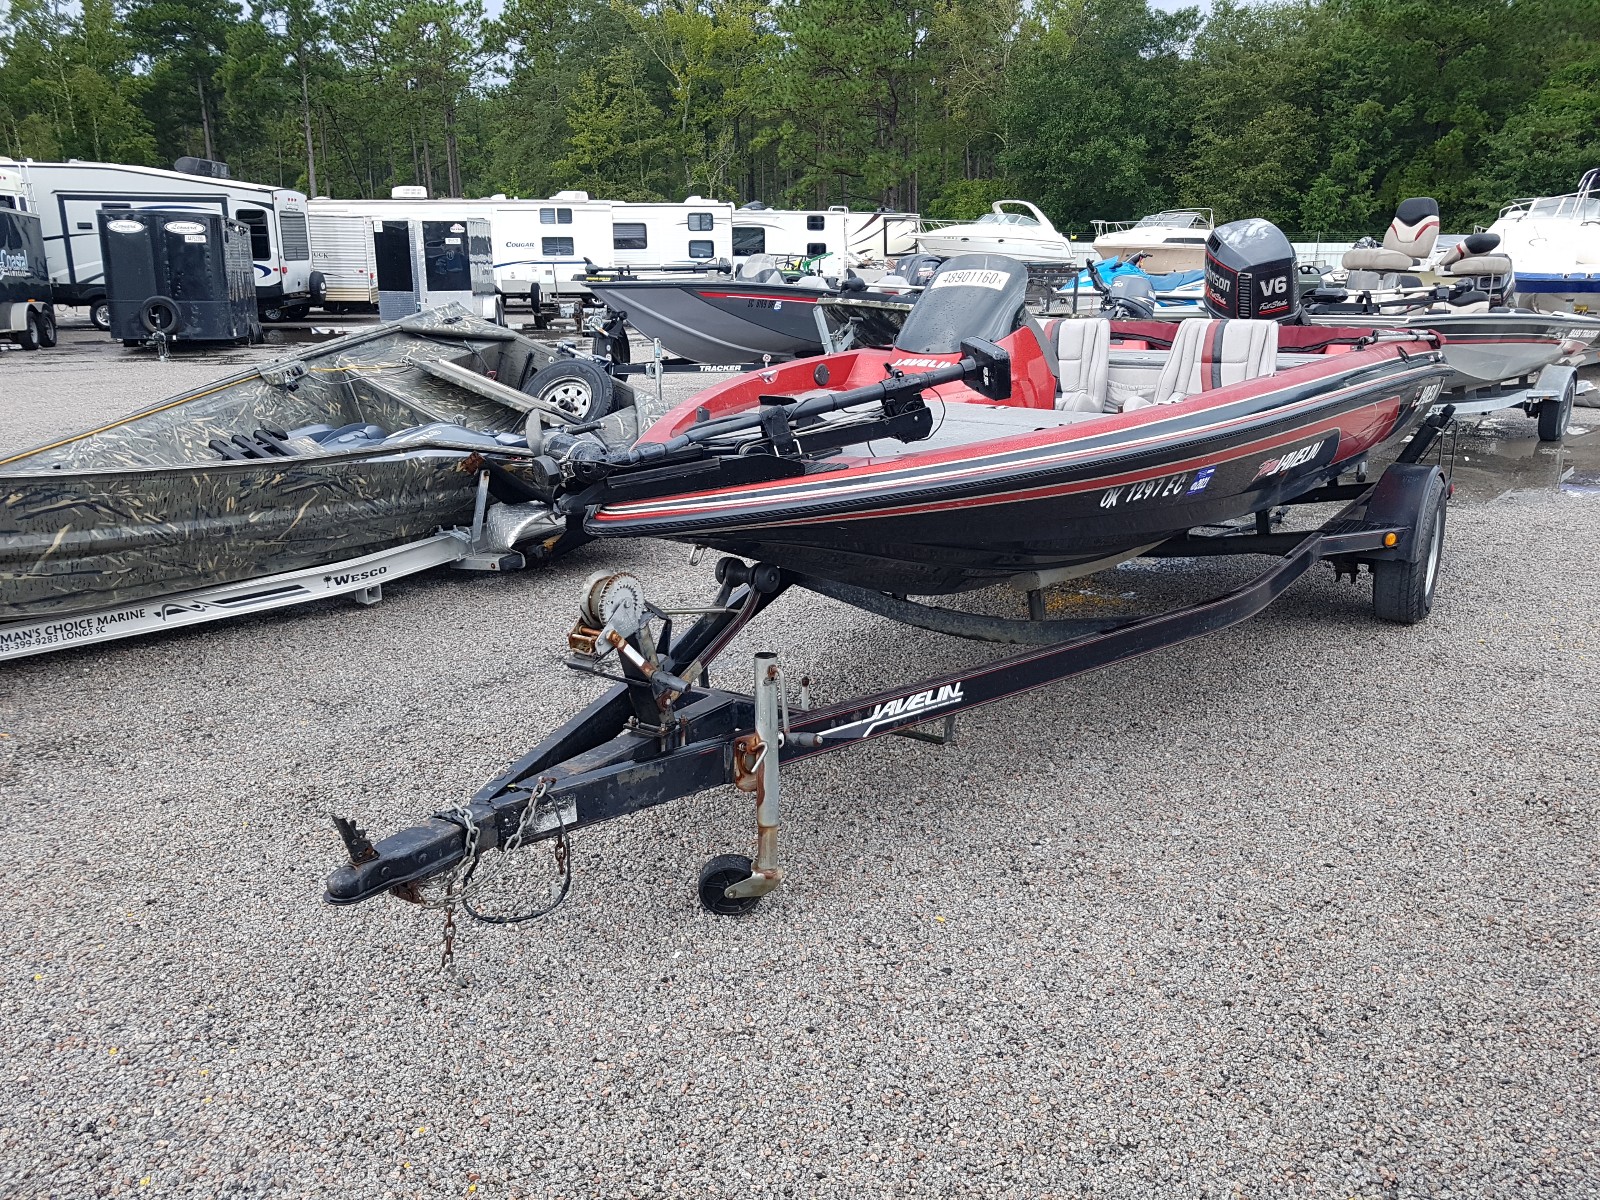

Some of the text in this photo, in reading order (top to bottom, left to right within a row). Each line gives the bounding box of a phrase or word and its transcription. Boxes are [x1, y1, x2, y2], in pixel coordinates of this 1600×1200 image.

[1260, 276, 1287, 297] V6
[1266, 440, 1324, 477] JAVELIN
[1100, 473, 1188, 509] OK 1297 EC
[333, 566, 388, 586] WESCO
[0, 608, 147, 645] MAN'S CHOICE MARINE
[62, 629, 93, 641] LONGS
[96, 625, 108, 635] SC
[866, 681, 964, 722] JAVELIN
